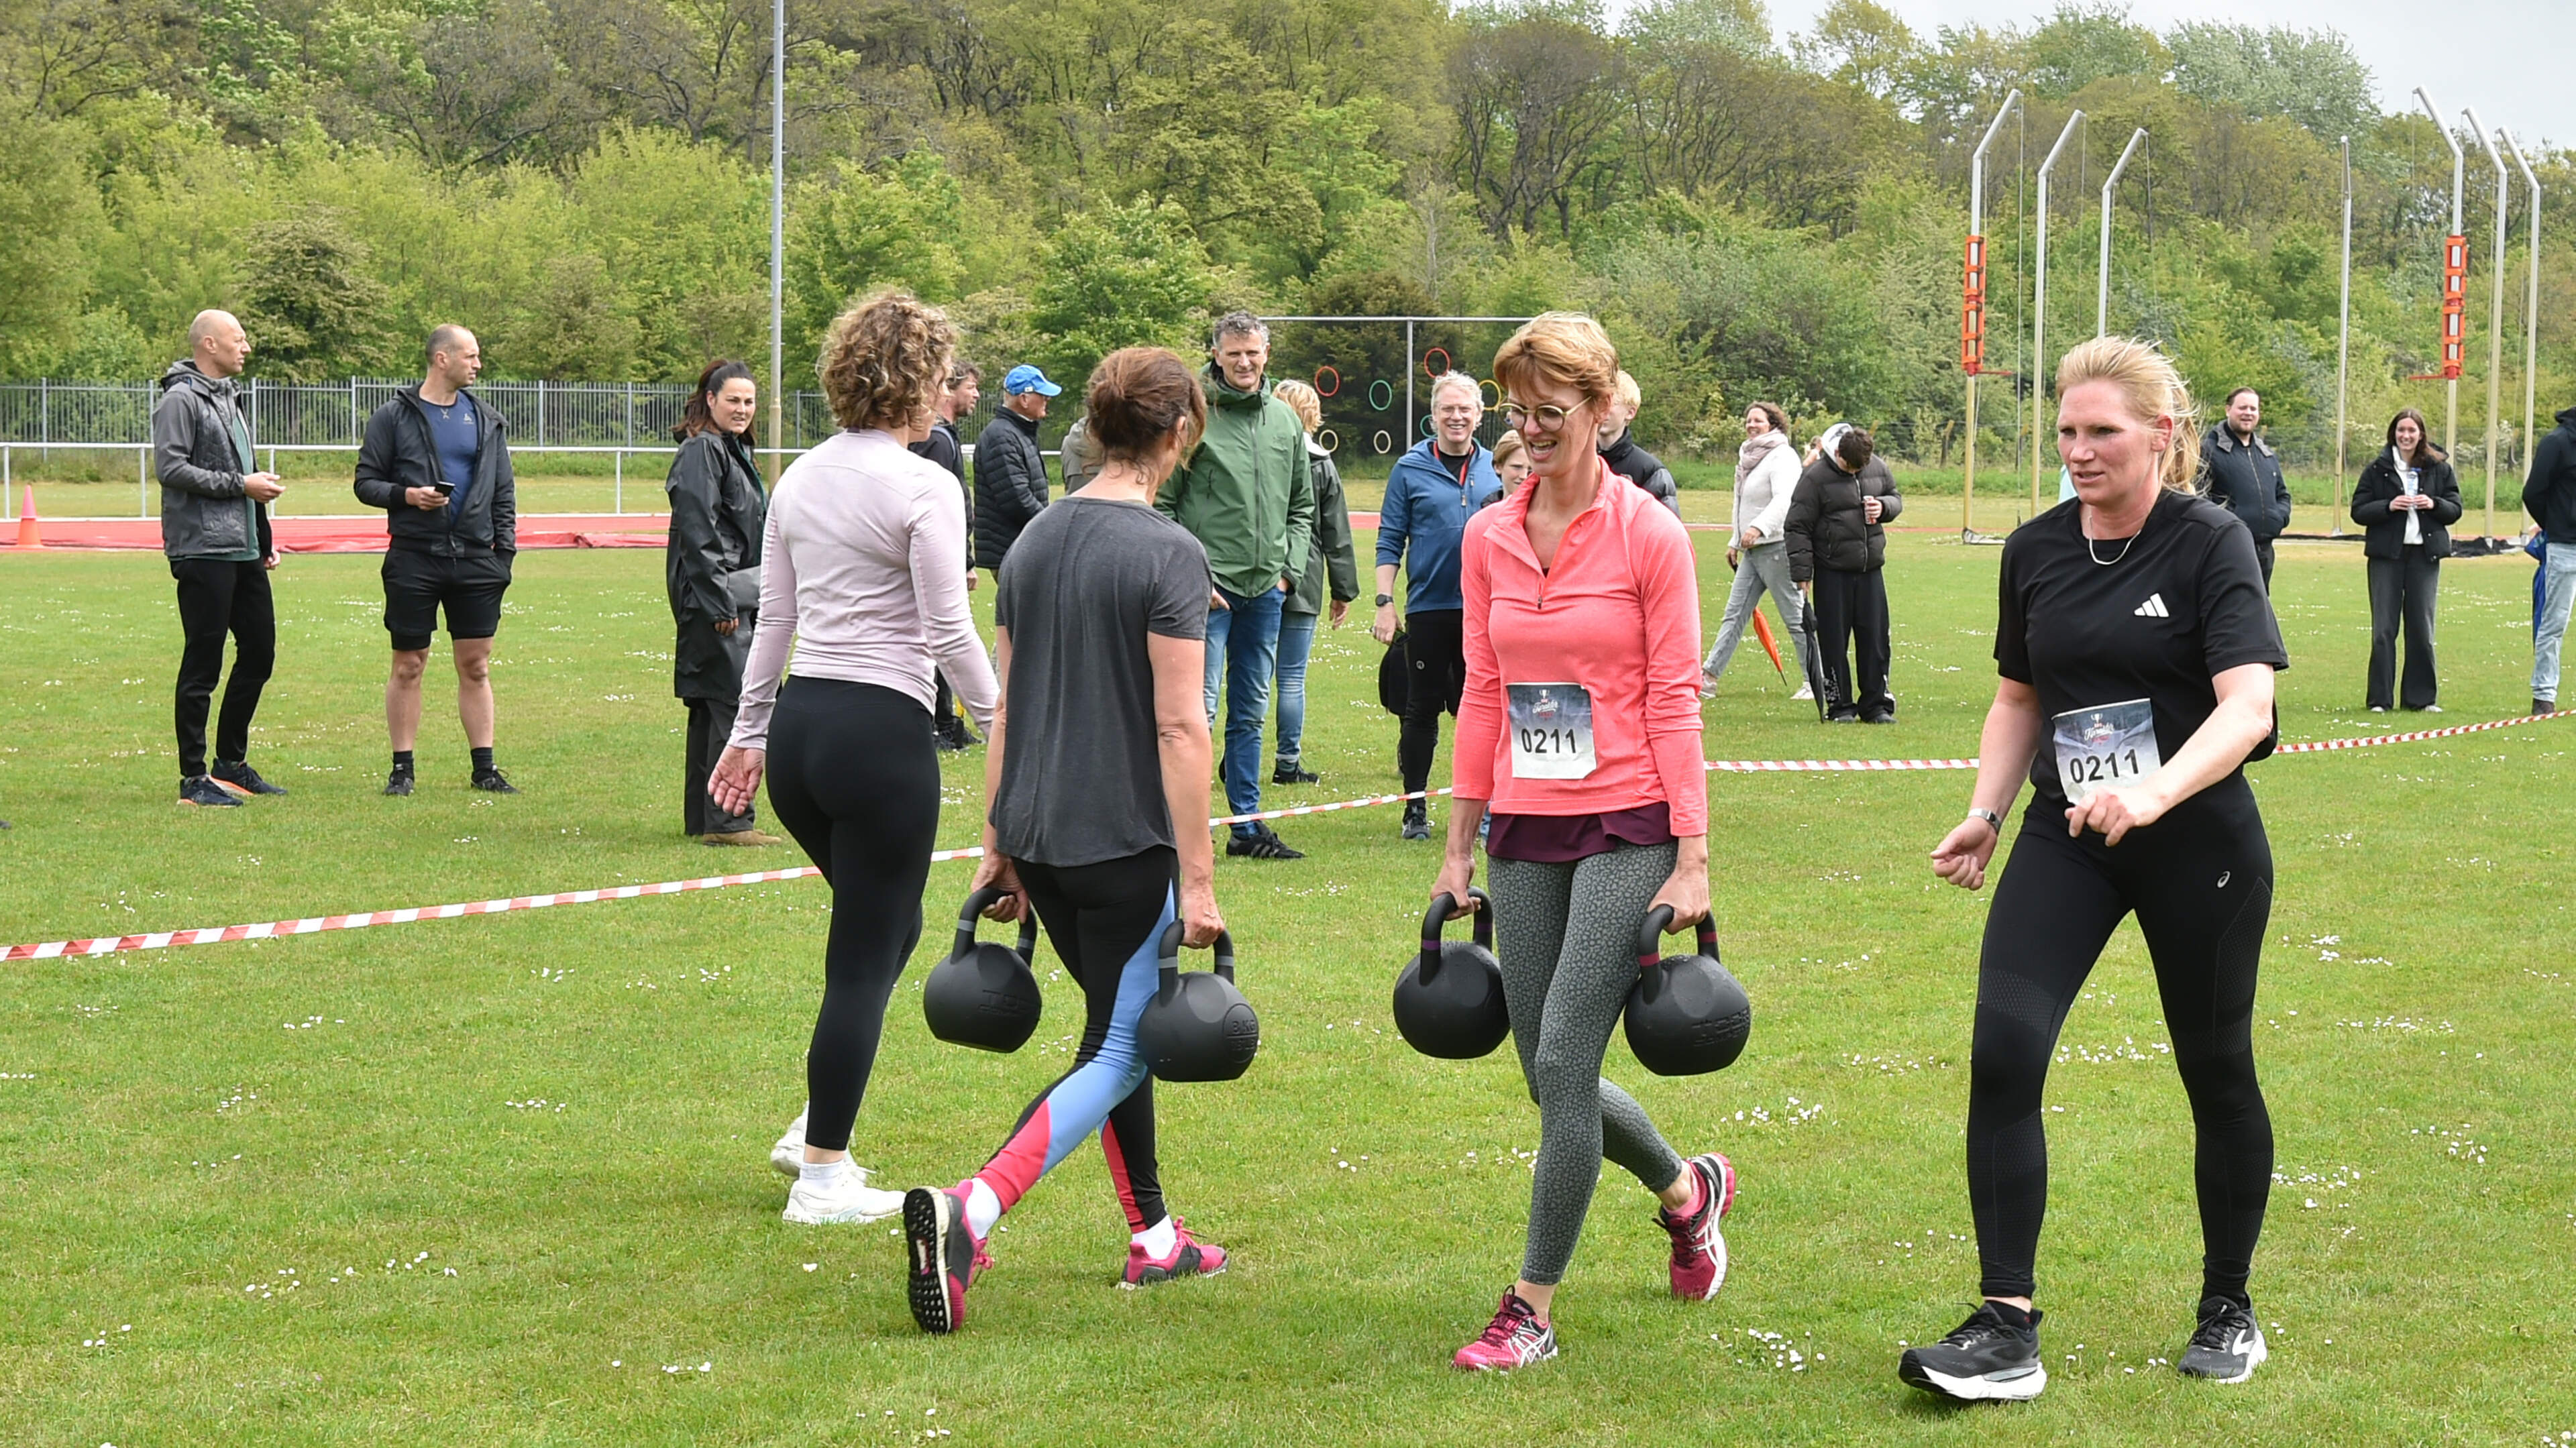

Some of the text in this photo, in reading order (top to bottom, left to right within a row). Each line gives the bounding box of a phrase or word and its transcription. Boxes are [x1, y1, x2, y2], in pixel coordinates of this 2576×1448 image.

[1521, 728, 1576, 754] 0211
[2069, 748, 2139, 784] 0211
[1242, 1019, 1256, 1033] KG
